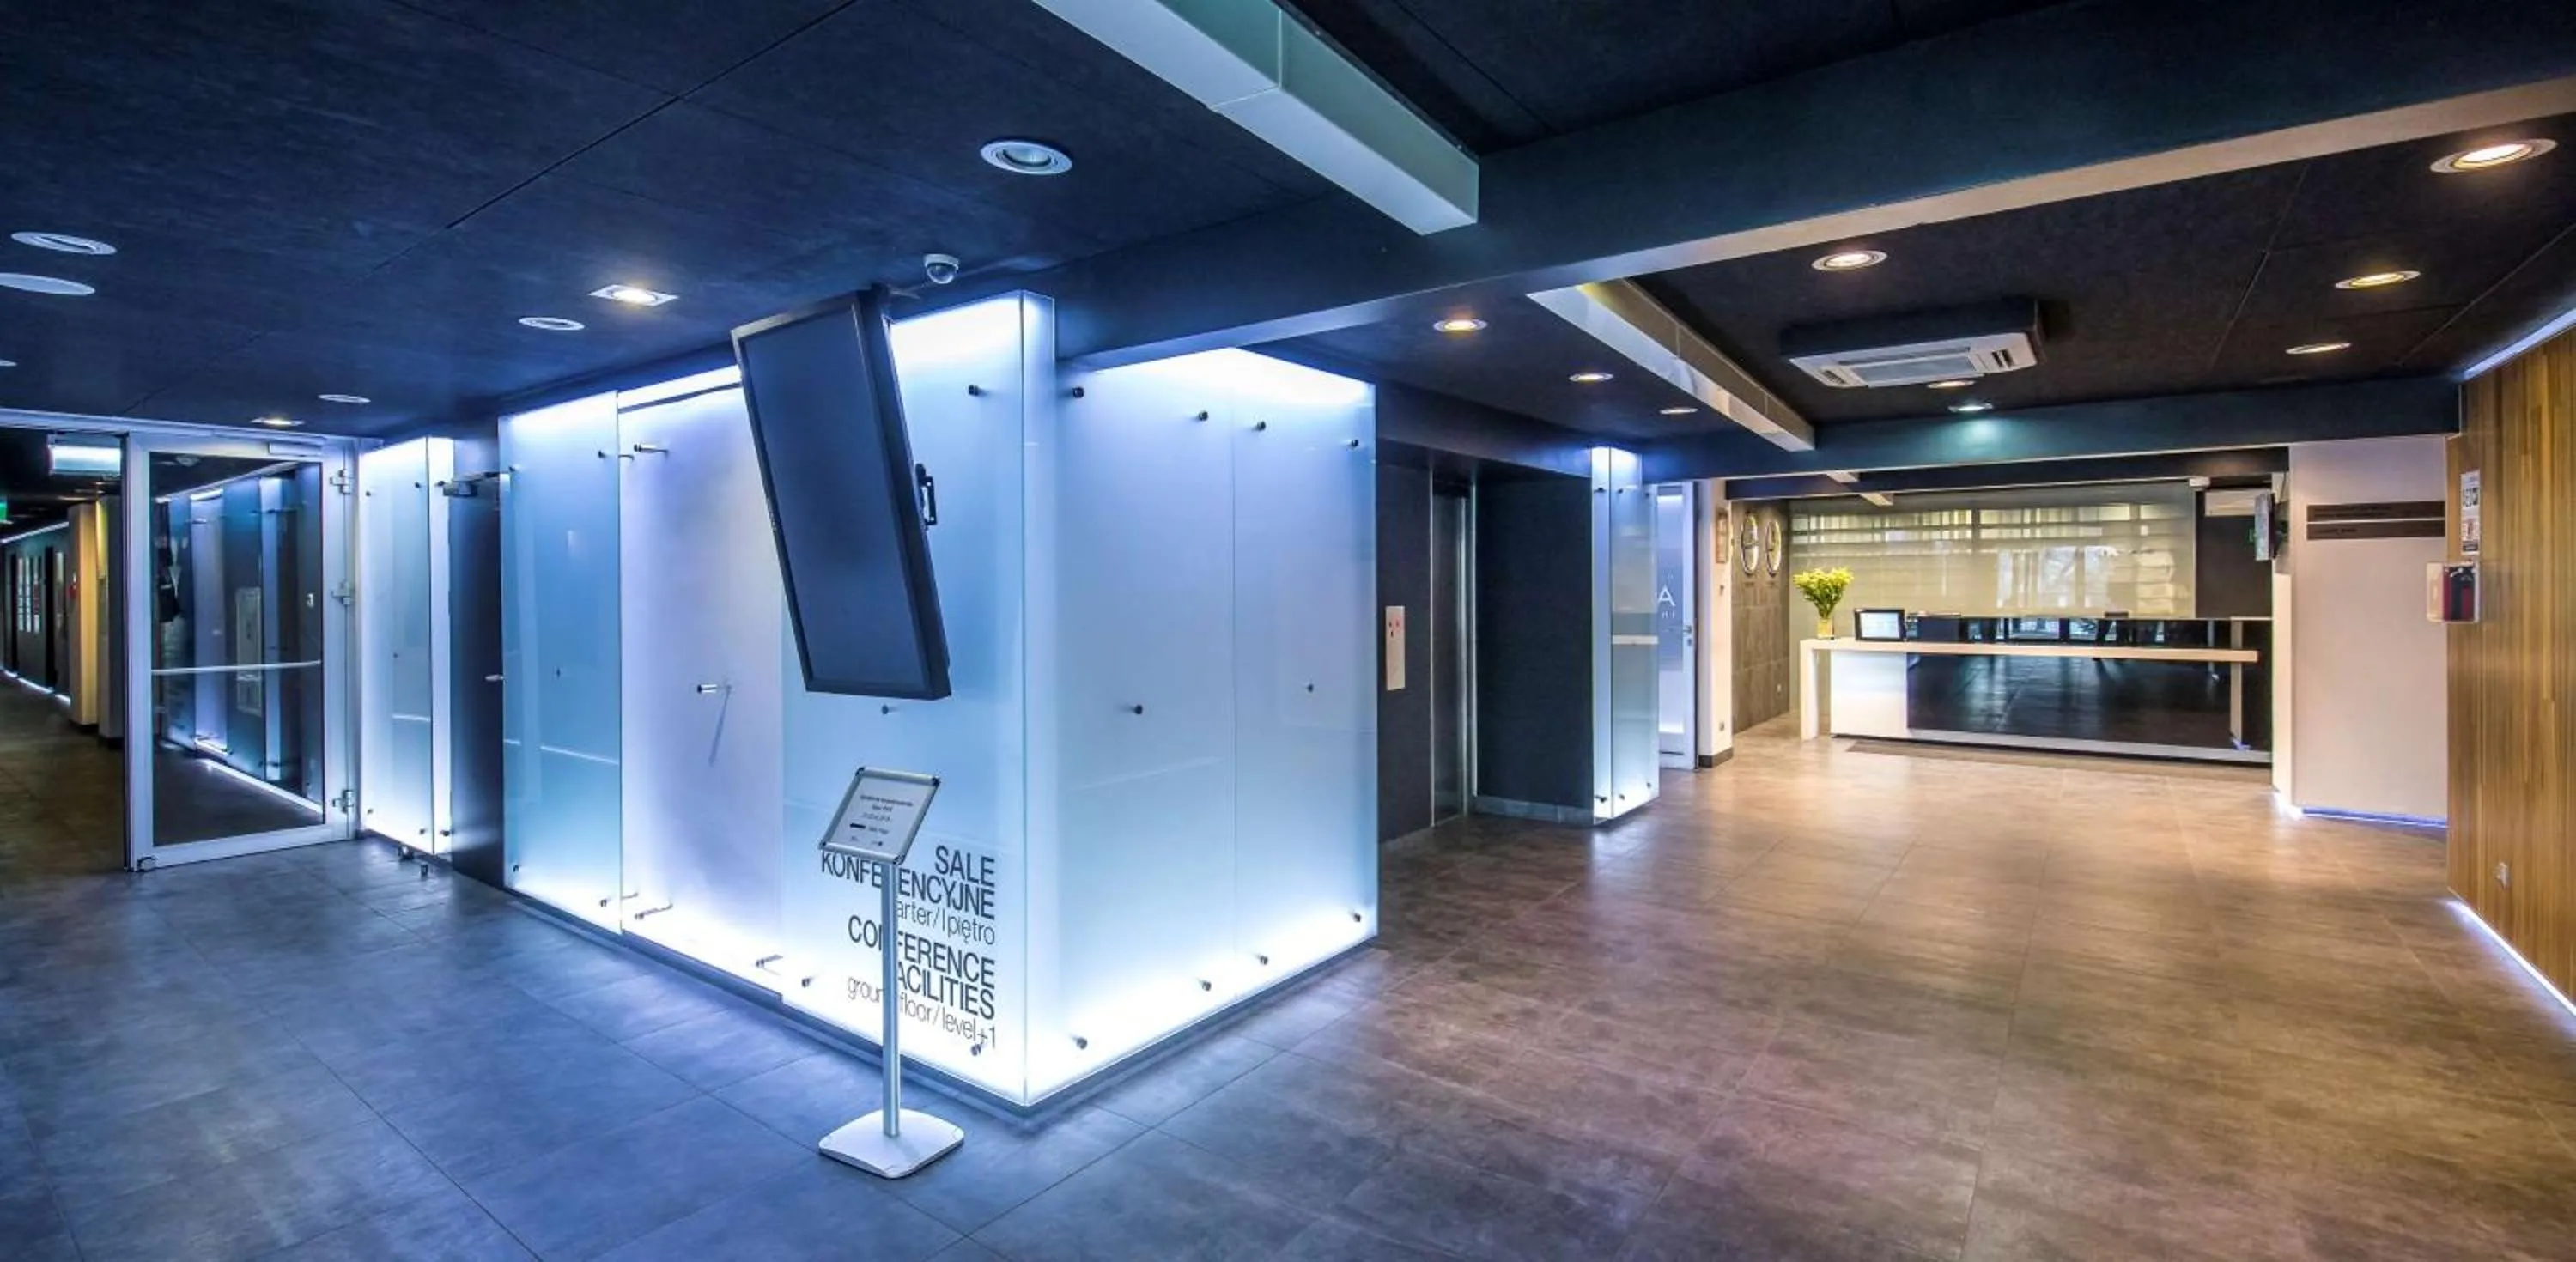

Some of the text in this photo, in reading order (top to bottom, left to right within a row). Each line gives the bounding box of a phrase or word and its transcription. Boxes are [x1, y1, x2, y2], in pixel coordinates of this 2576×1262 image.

[822, 850, 995, 920] KONFEENCYJNE
[935, 845, 995, 888] SALE
[848, 914, 995, 989] COERENCE
[847, 977, 884, 1004] grou
[897, 961, 995, 1021] ACILITIES
